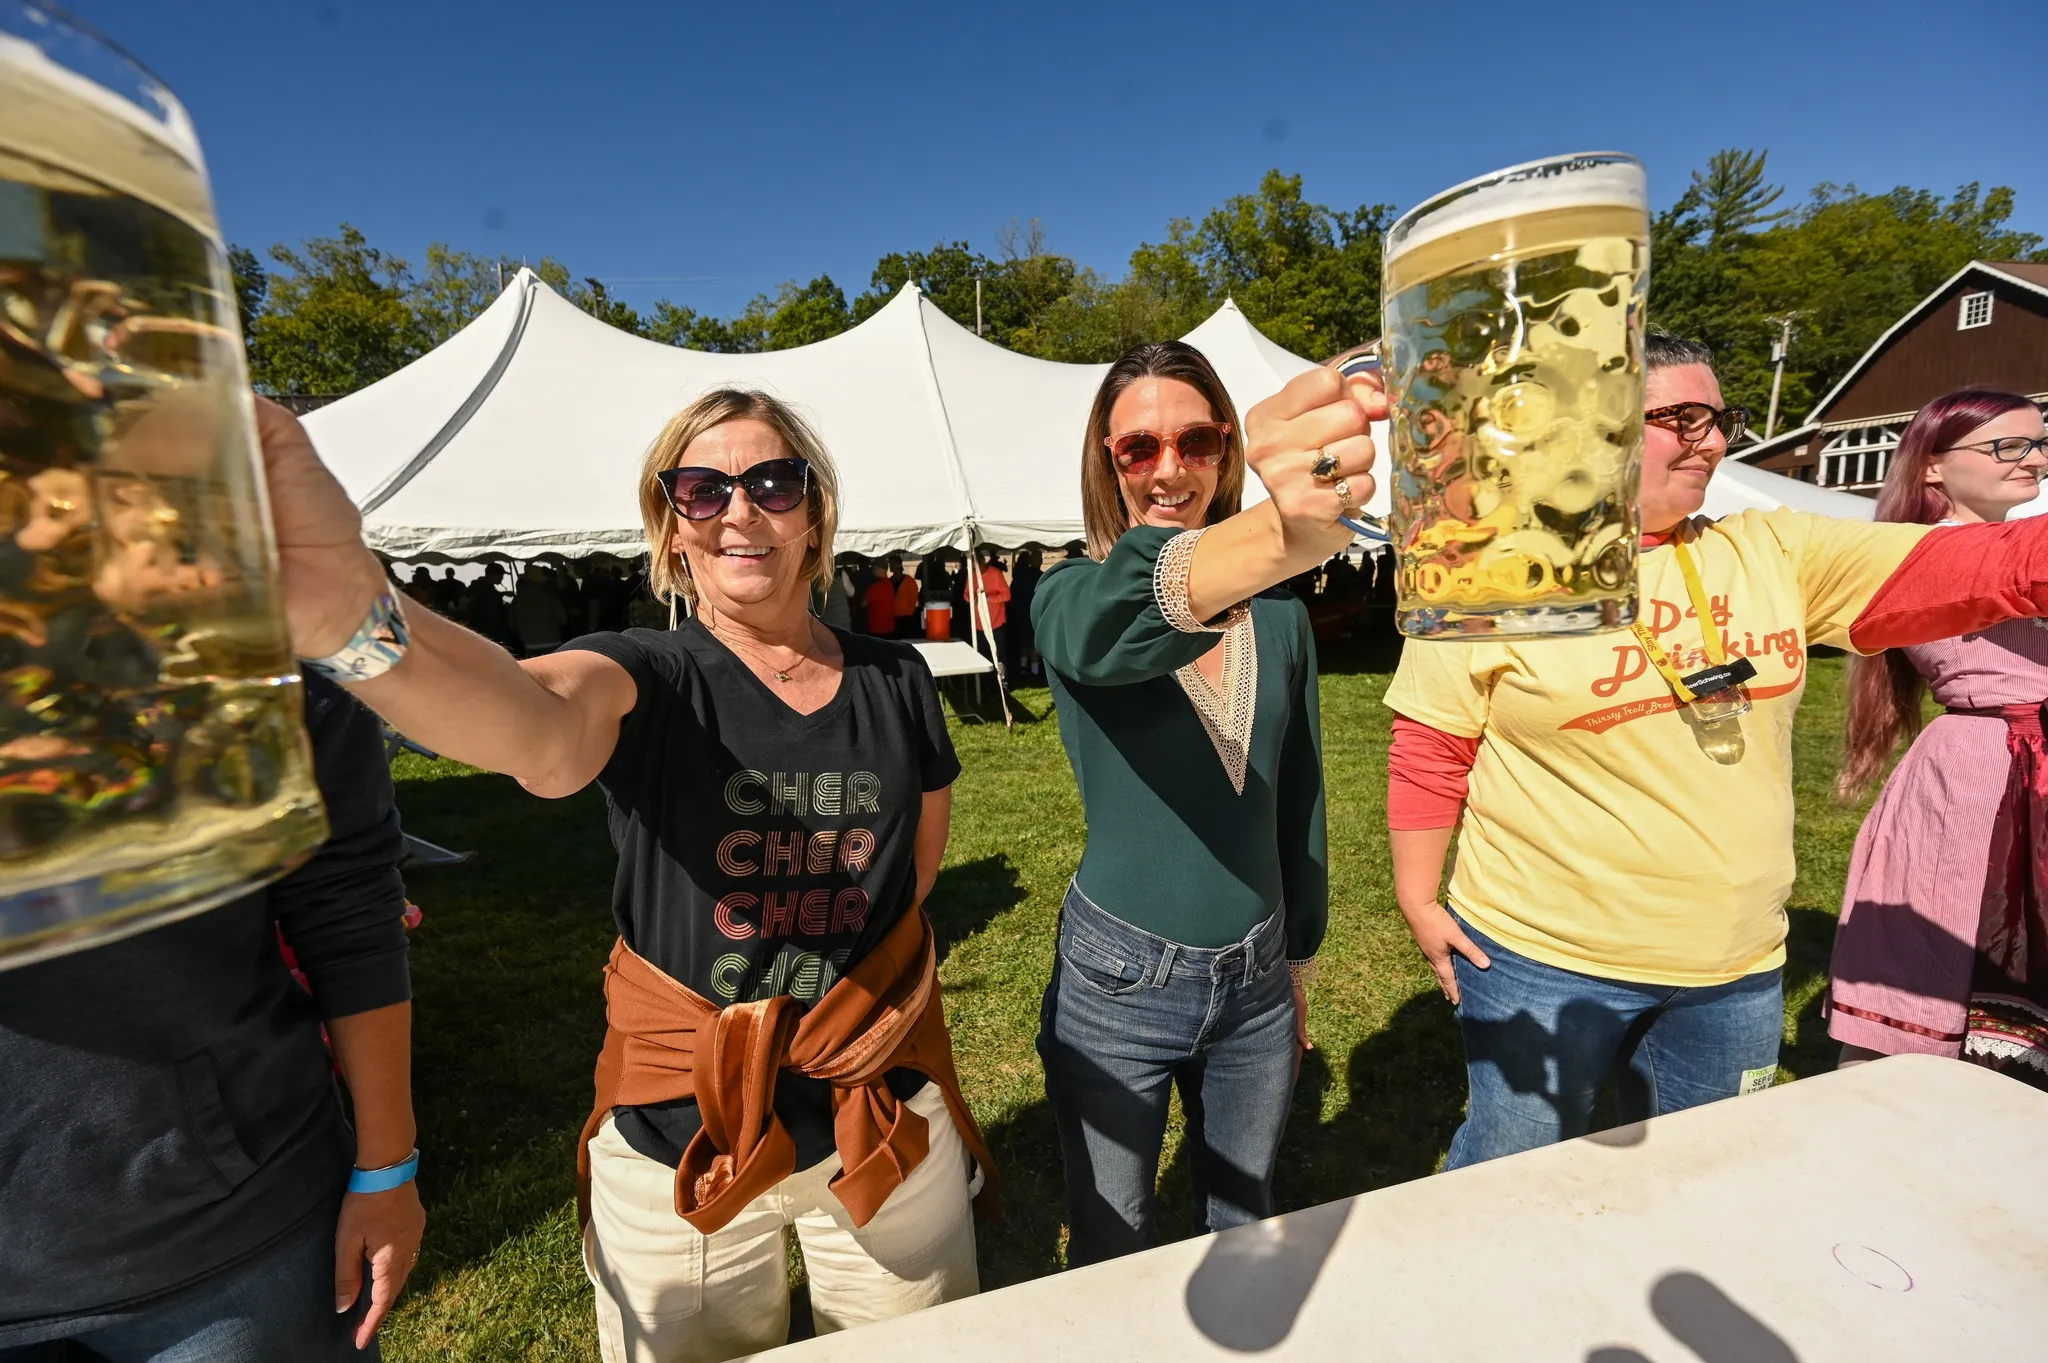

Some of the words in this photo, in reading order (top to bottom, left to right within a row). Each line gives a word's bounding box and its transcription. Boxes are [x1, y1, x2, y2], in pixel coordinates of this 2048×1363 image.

[1646, 594, 1734, 640] Dy
[1590, 627, 1803, 698] Dinking
[1584, 711, 1623, 728] Thirsty
[1622, 703, 1645, 716] Troll
[724, 769, 881, 816] CHER
[716, 828, 876, 877] CHER
[713, 887, 870, 941] CHER
[1752, 1076, 1767, 1087] SEP
